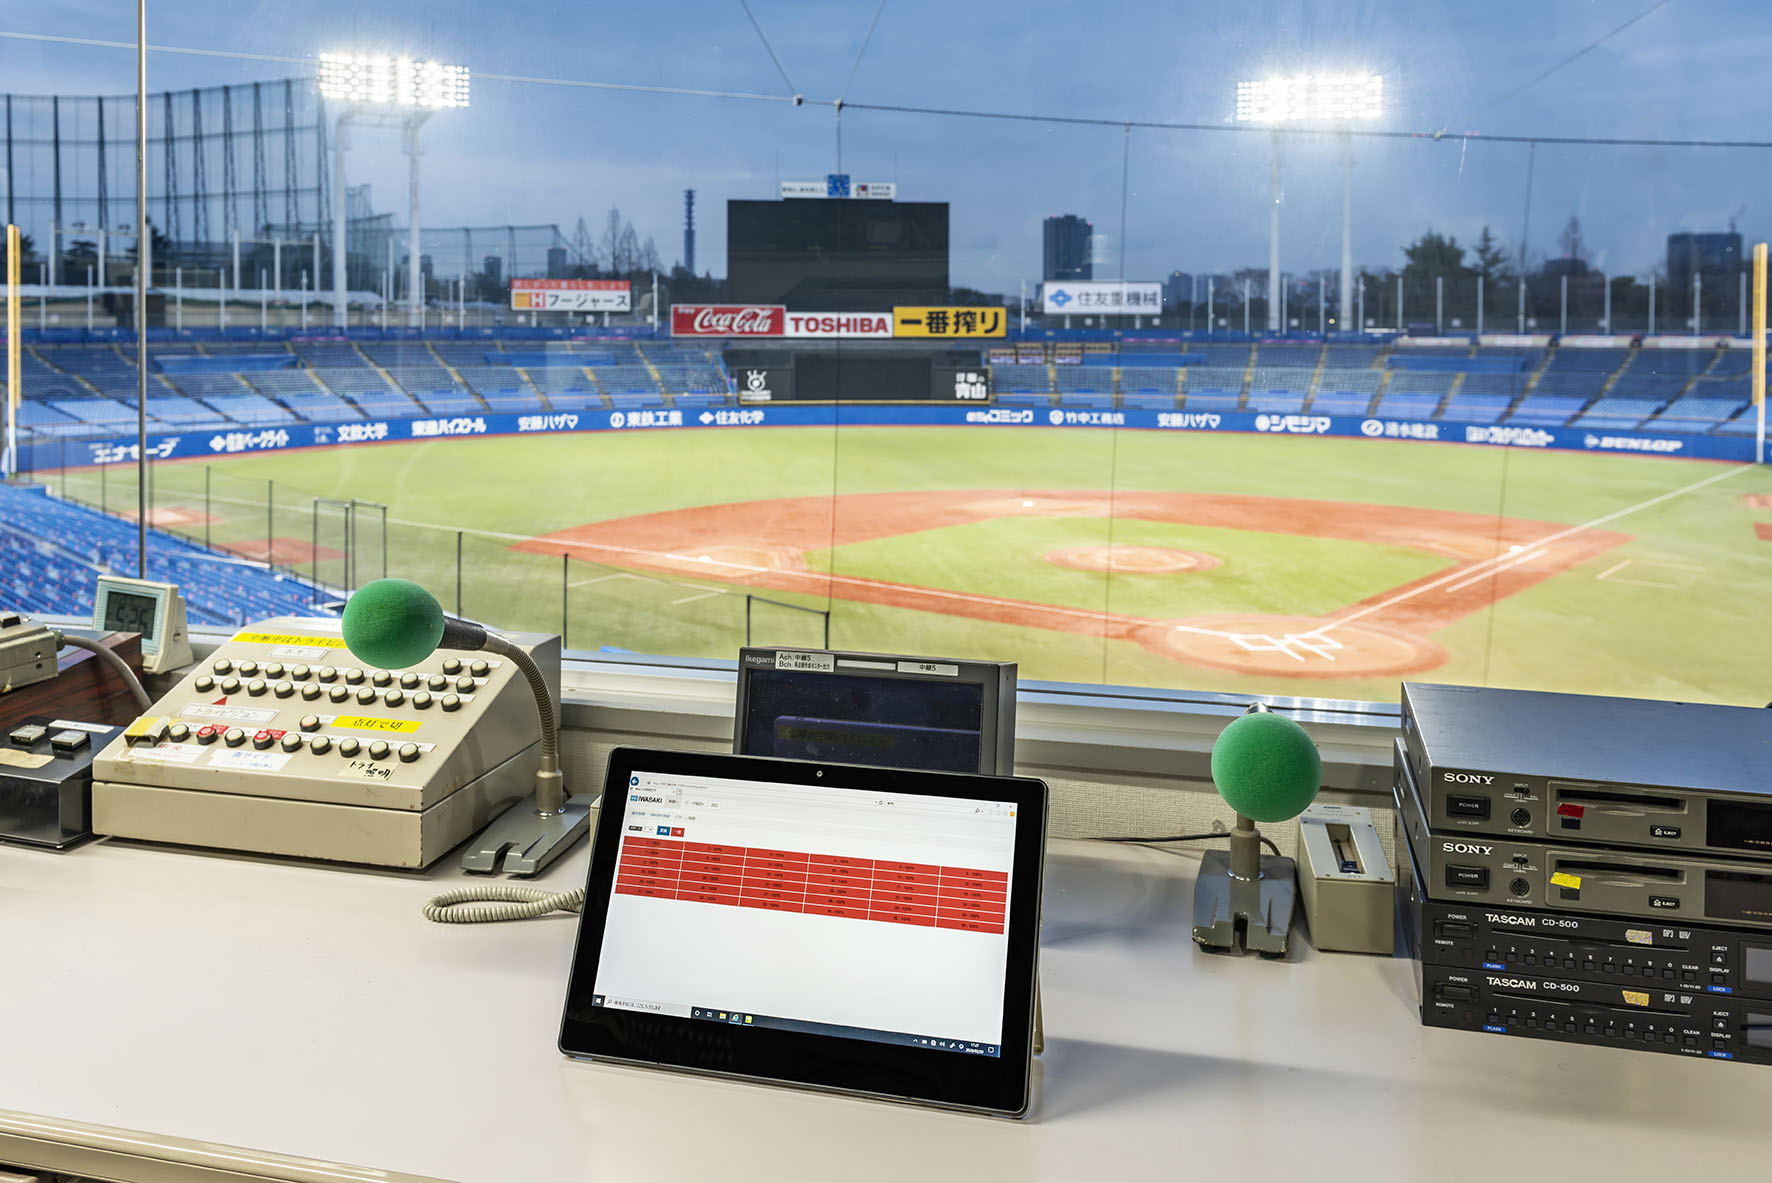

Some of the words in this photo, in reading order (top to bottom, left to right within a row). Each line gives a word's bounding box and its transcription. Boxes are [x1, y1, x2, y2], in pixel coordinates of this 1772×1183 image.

[548, 294, 628, 308] フージャース
[693, 308, 774, 334] Coca-Cola
[790, 317, 888, 333] TOSHIBA
[901, 311, 999, 334] 一番搾り
[715, 411, 765, 425] 住友化学
[745, 655, 775, 665] Ikegami
[1443, 772, 1495, 785] SONY
[1442, 842, 1494, 856] SONY
[1485, 913, 1536, 926] TASCAM
[1541, 918, 1579, 929] CD-500
[1487, 976, 1537, 990] TASCAM
[1543, 981, 1580, 993] CD-500
